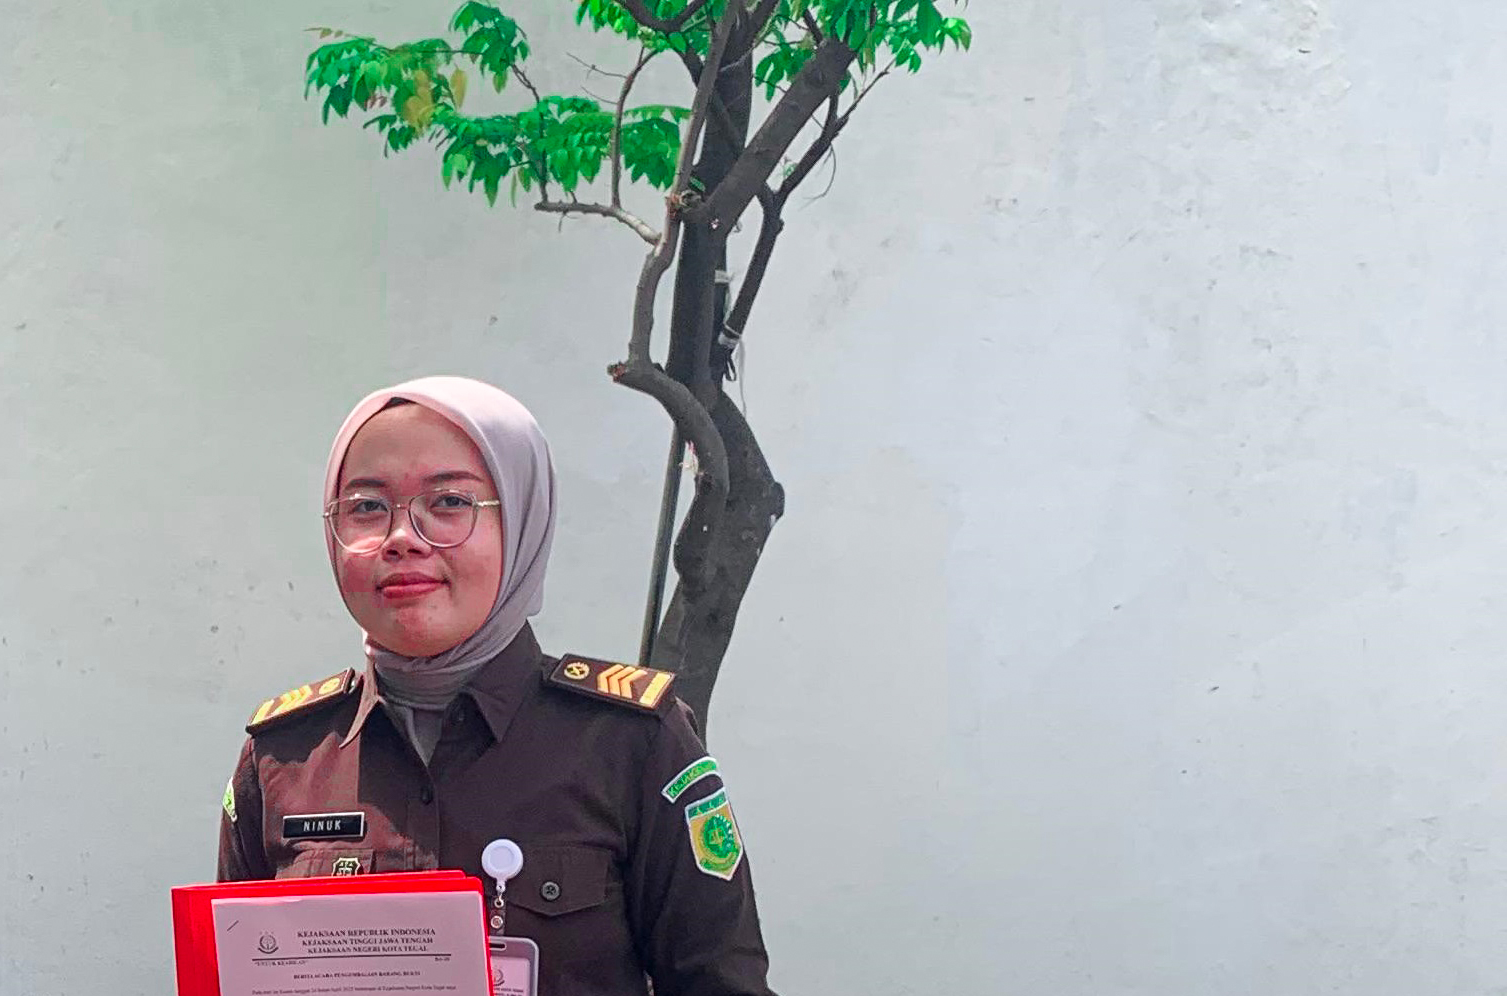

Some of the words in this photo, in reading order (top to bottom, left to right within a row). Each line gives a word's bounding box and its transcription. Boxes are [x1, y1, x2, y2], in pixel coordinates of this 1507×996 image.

[303, 820, 342, 832] NINUK
[297, 930, 345, 938] KEJAKSAAN
[347, 929, 389, 937] REPUBLIK
[390, 928, 436, 936] INDONESIA
[302, 938, 348, 946] KEJAKSAAN
[400, 936, 433, 944] TENGAH
